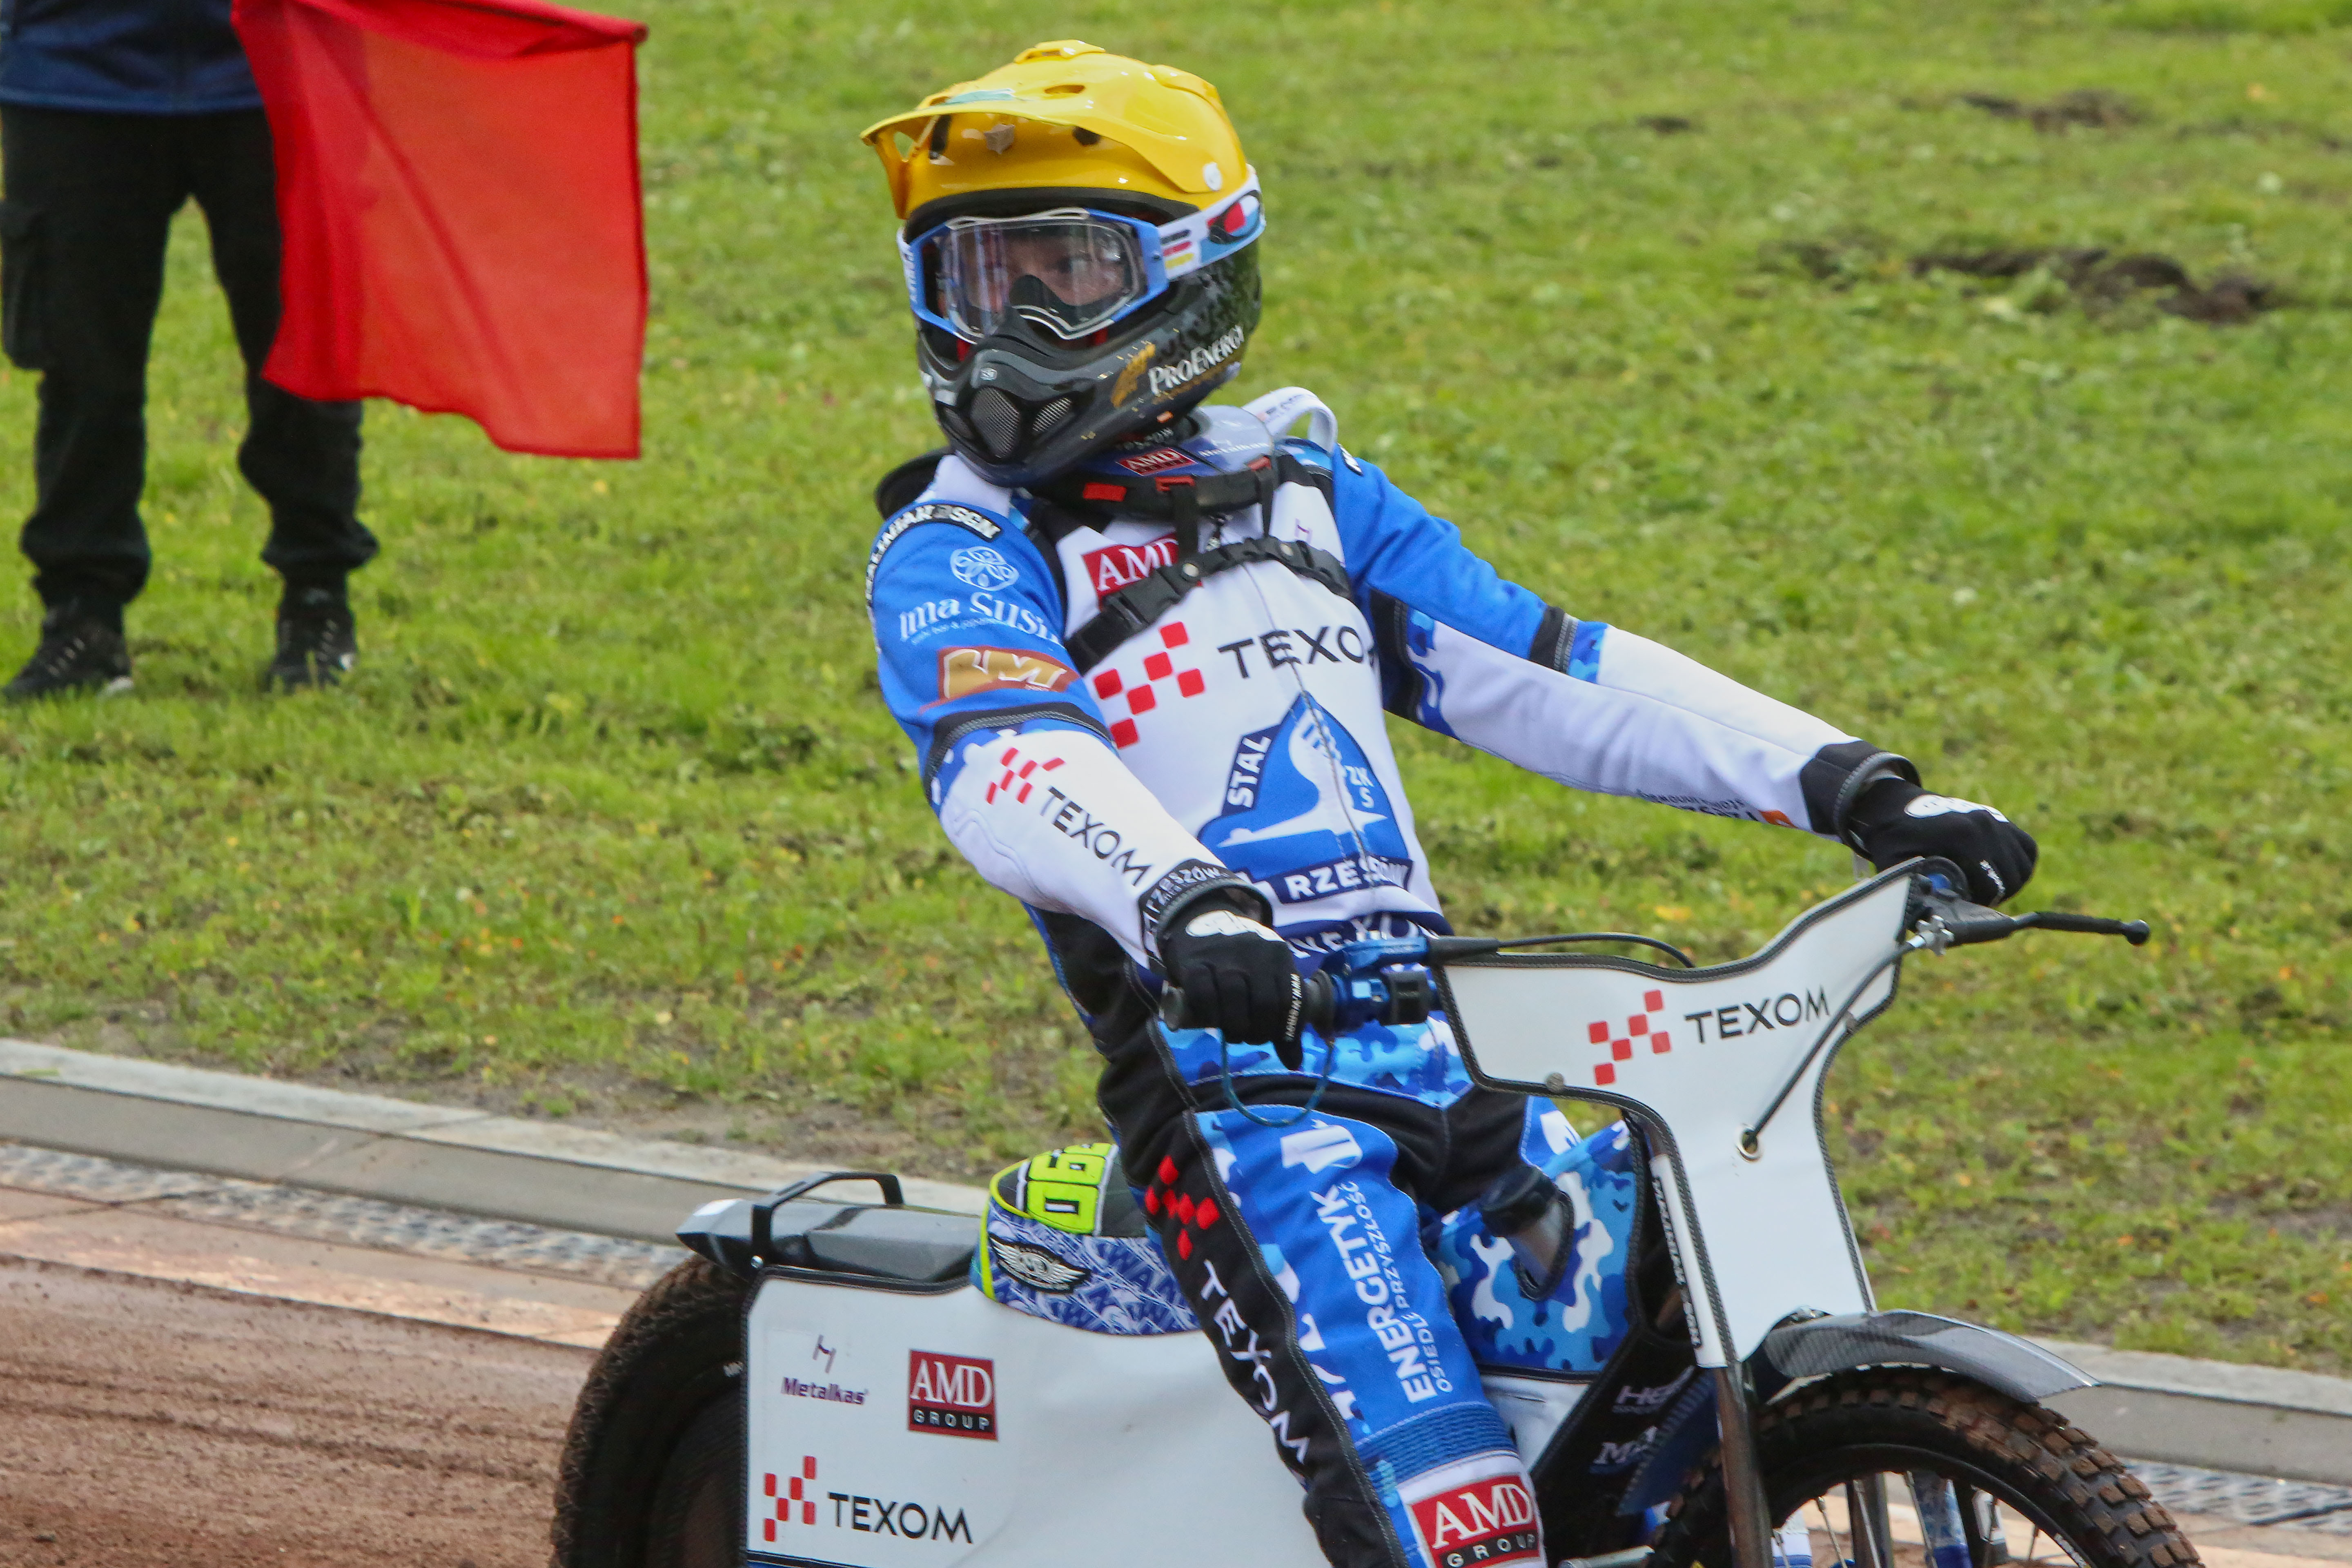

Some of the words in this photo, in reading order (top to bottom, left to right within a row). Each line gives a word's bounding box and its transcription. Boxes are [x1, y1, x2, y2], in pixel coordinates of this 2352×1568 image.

[1127, 450, 1180, 470] AMD
[1216, 625, 1377, 680] TEXO
[1226, 736, 1272, 809] STAL
[1040, 785, 1152, 886] TEXOM
[1684, 985, 1830, 1045] TEXOM
[1310, 1184, 1438, 1403] ENERGETYK
[910, 1359, 993, 1408] AMD
[913, 1409, 990, 1430] GROUP
[827, 1491, 973, 1545] TEXOM
[1432, 1483, 1534, 1549] AMD
[1446, 1534, 1536, 1568] GROUP
